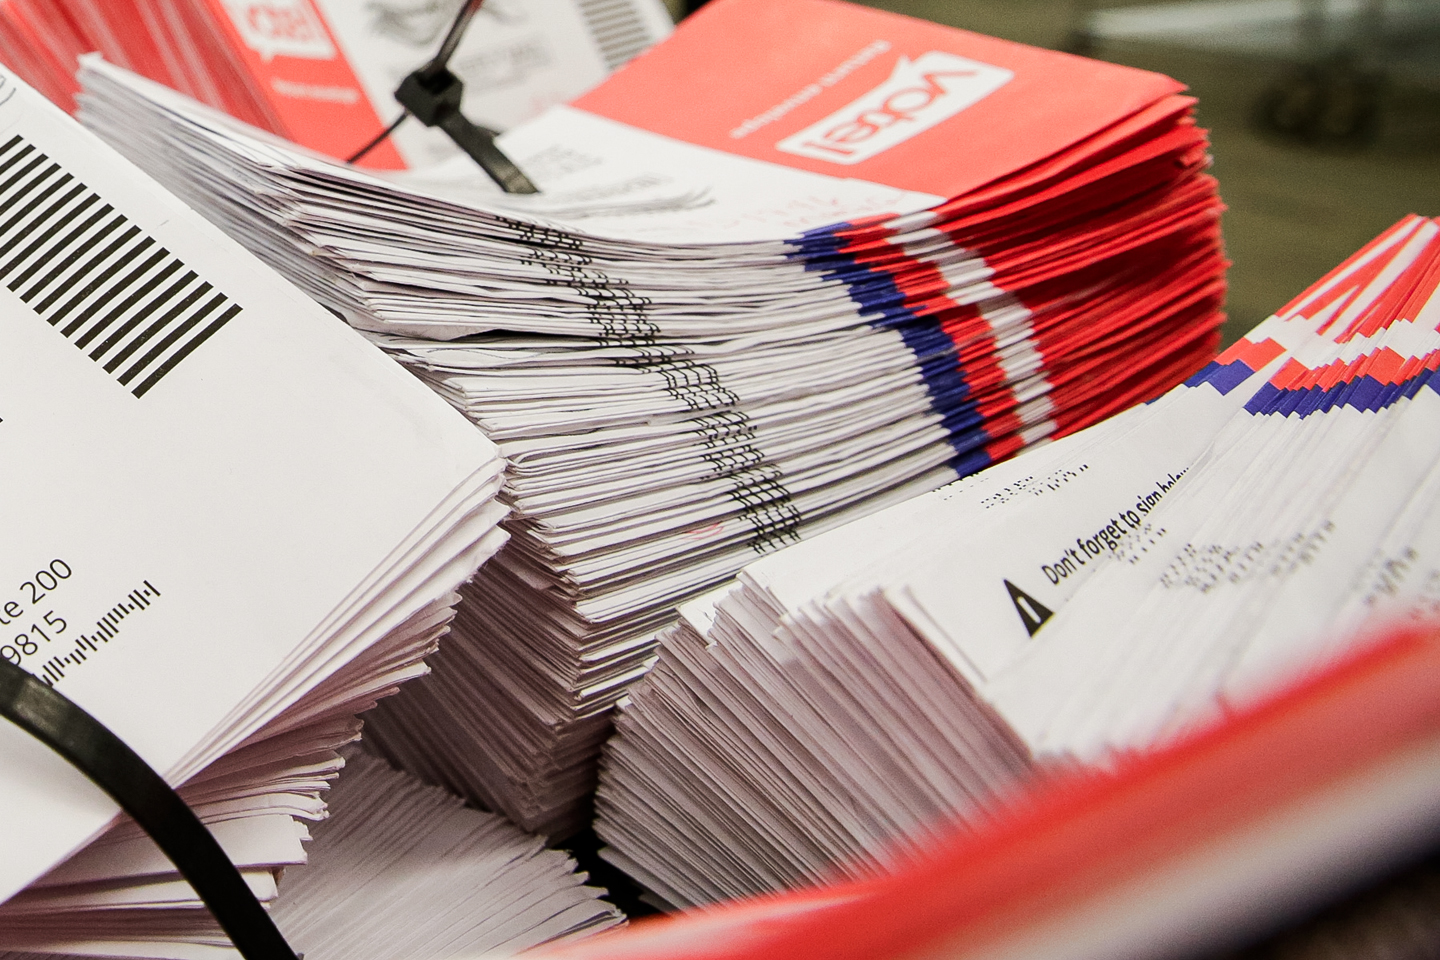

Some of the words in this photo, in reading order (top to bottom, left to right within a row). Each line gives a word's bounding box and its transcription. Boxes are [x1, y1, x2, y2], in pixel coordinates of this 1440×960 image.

[1041, 548, 1086, 585] Don't
[1076, 518, 1127, 559] forget
[1118, 510, 1141, 530] to
[19, 559, 72, 604] 200
